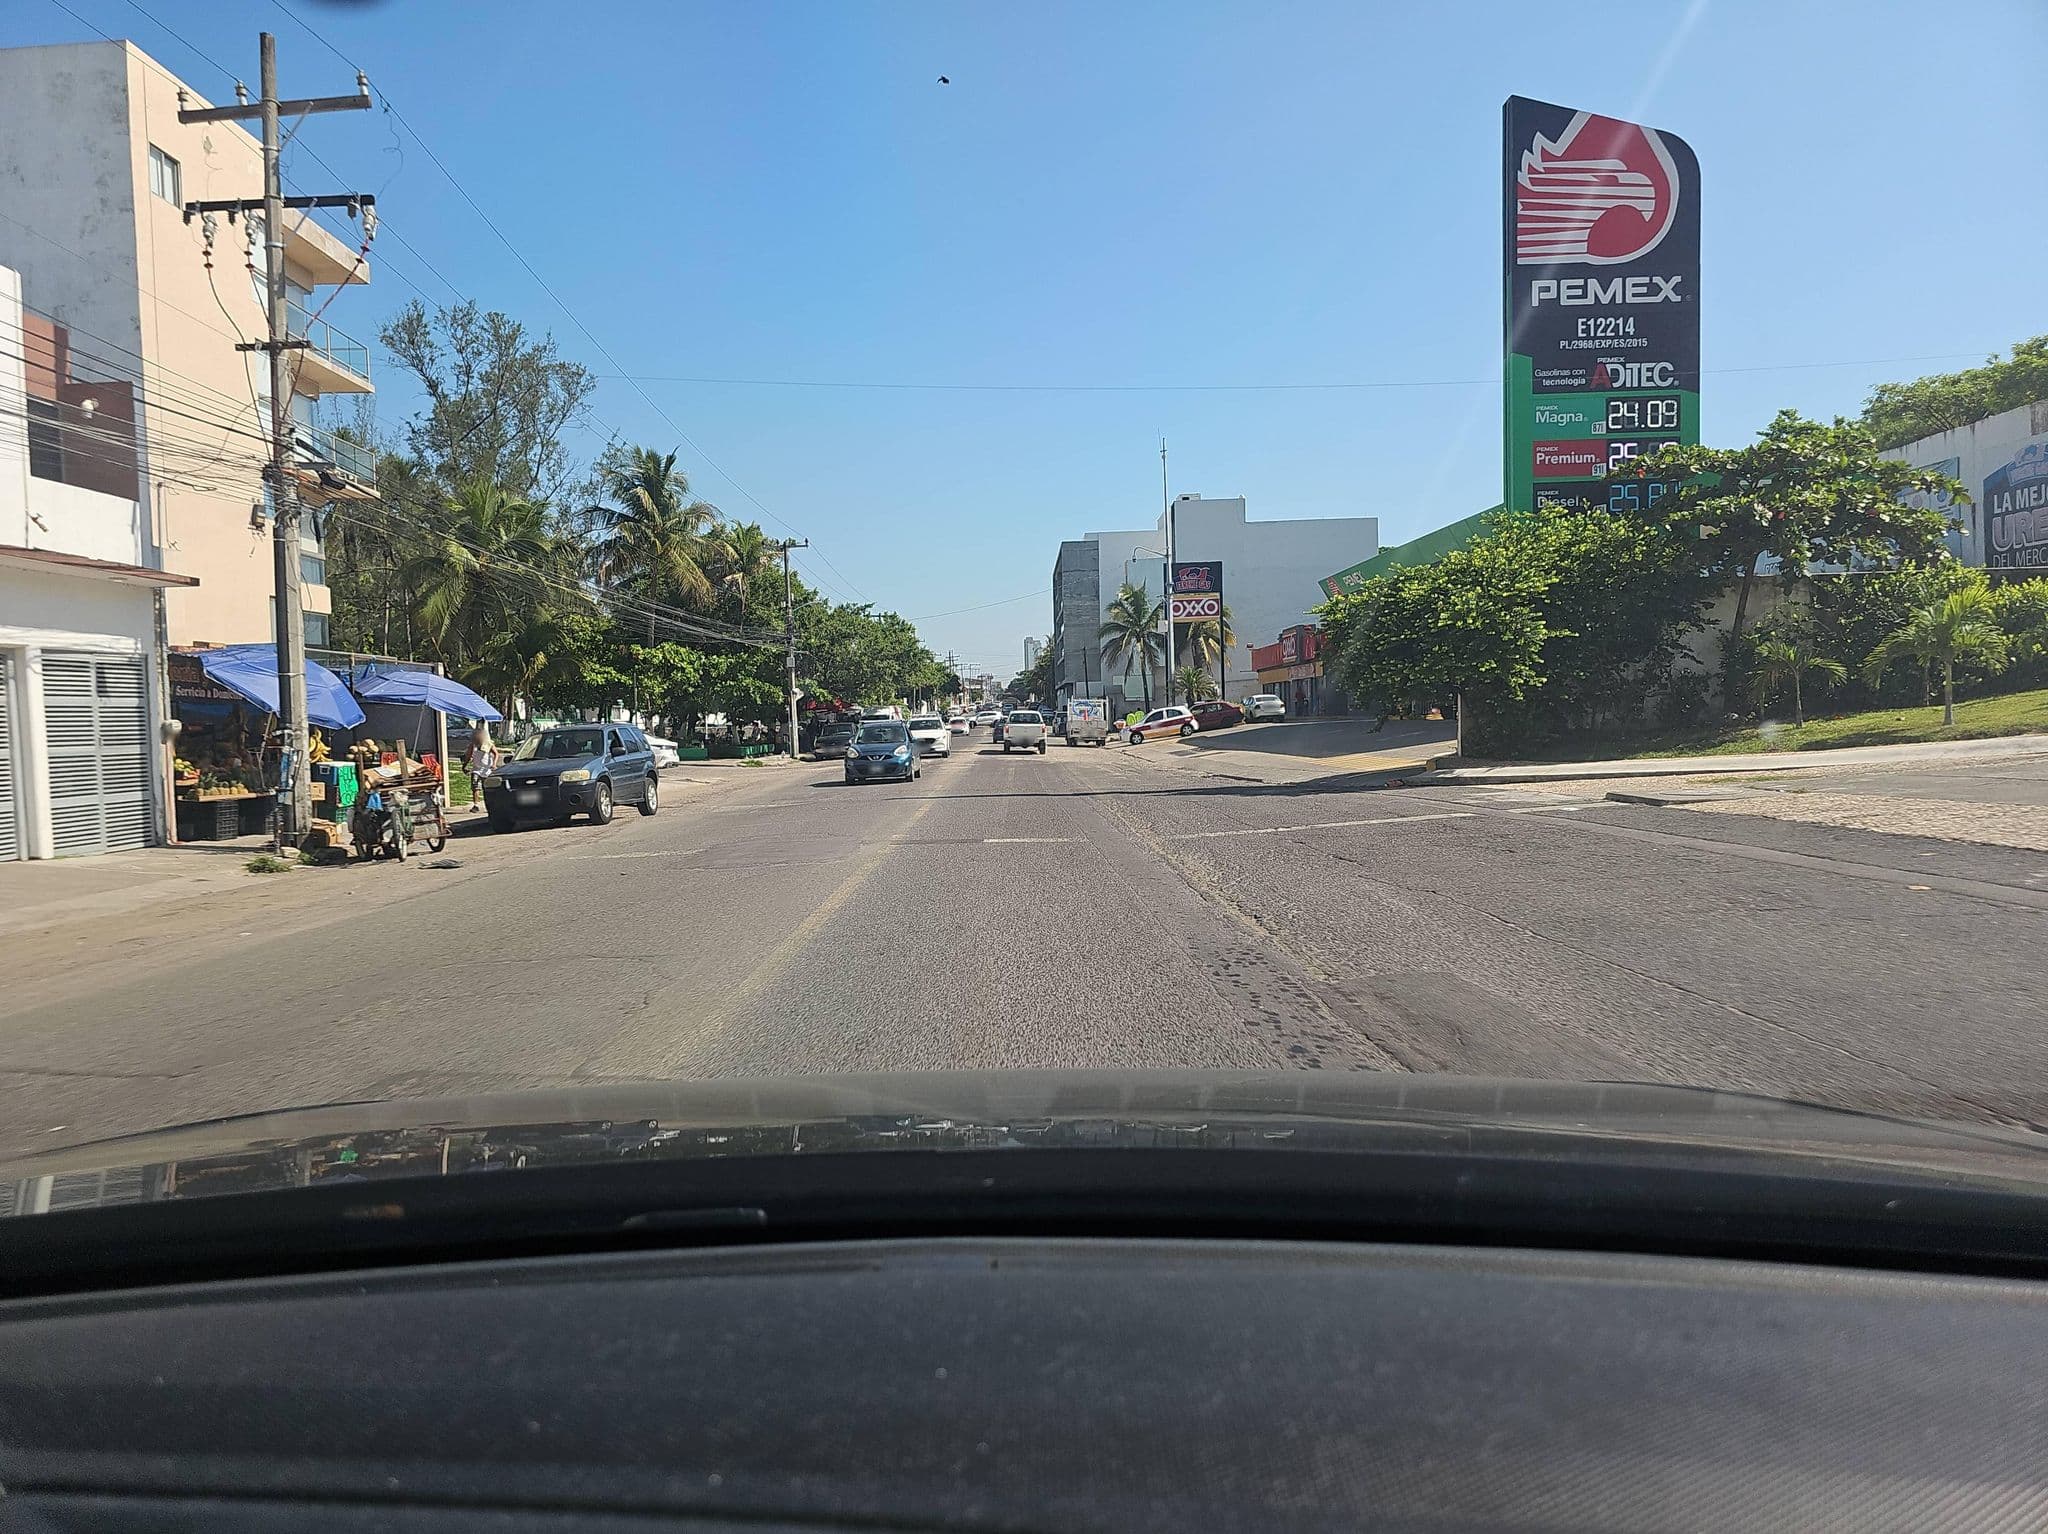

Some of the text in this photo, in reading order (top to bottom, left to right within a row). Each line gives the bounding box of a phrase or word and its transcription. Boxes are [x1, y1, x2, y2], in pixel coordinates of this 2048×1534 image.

[1531, 275, 1682, 307] PEMEX
[1577, 317, 1635, 338] E12214
[1559, 337, 1648, 350] PL/2968/EXP/ES/2015
[1534, 368, 1571, 378] Gasolinas
[1535, 411, 1583, 427] Magna
[1608, 400, 1678, 429] 24.09
[1536, 450, 1596, 466] Premium
[1993, 483, 2048, 514] LA MEJ
[1993, 547, 2048, 568] DEL MERC
[1172, 599, 1219, 617] OXXO
[175, 685, 206, 698] Servicio
